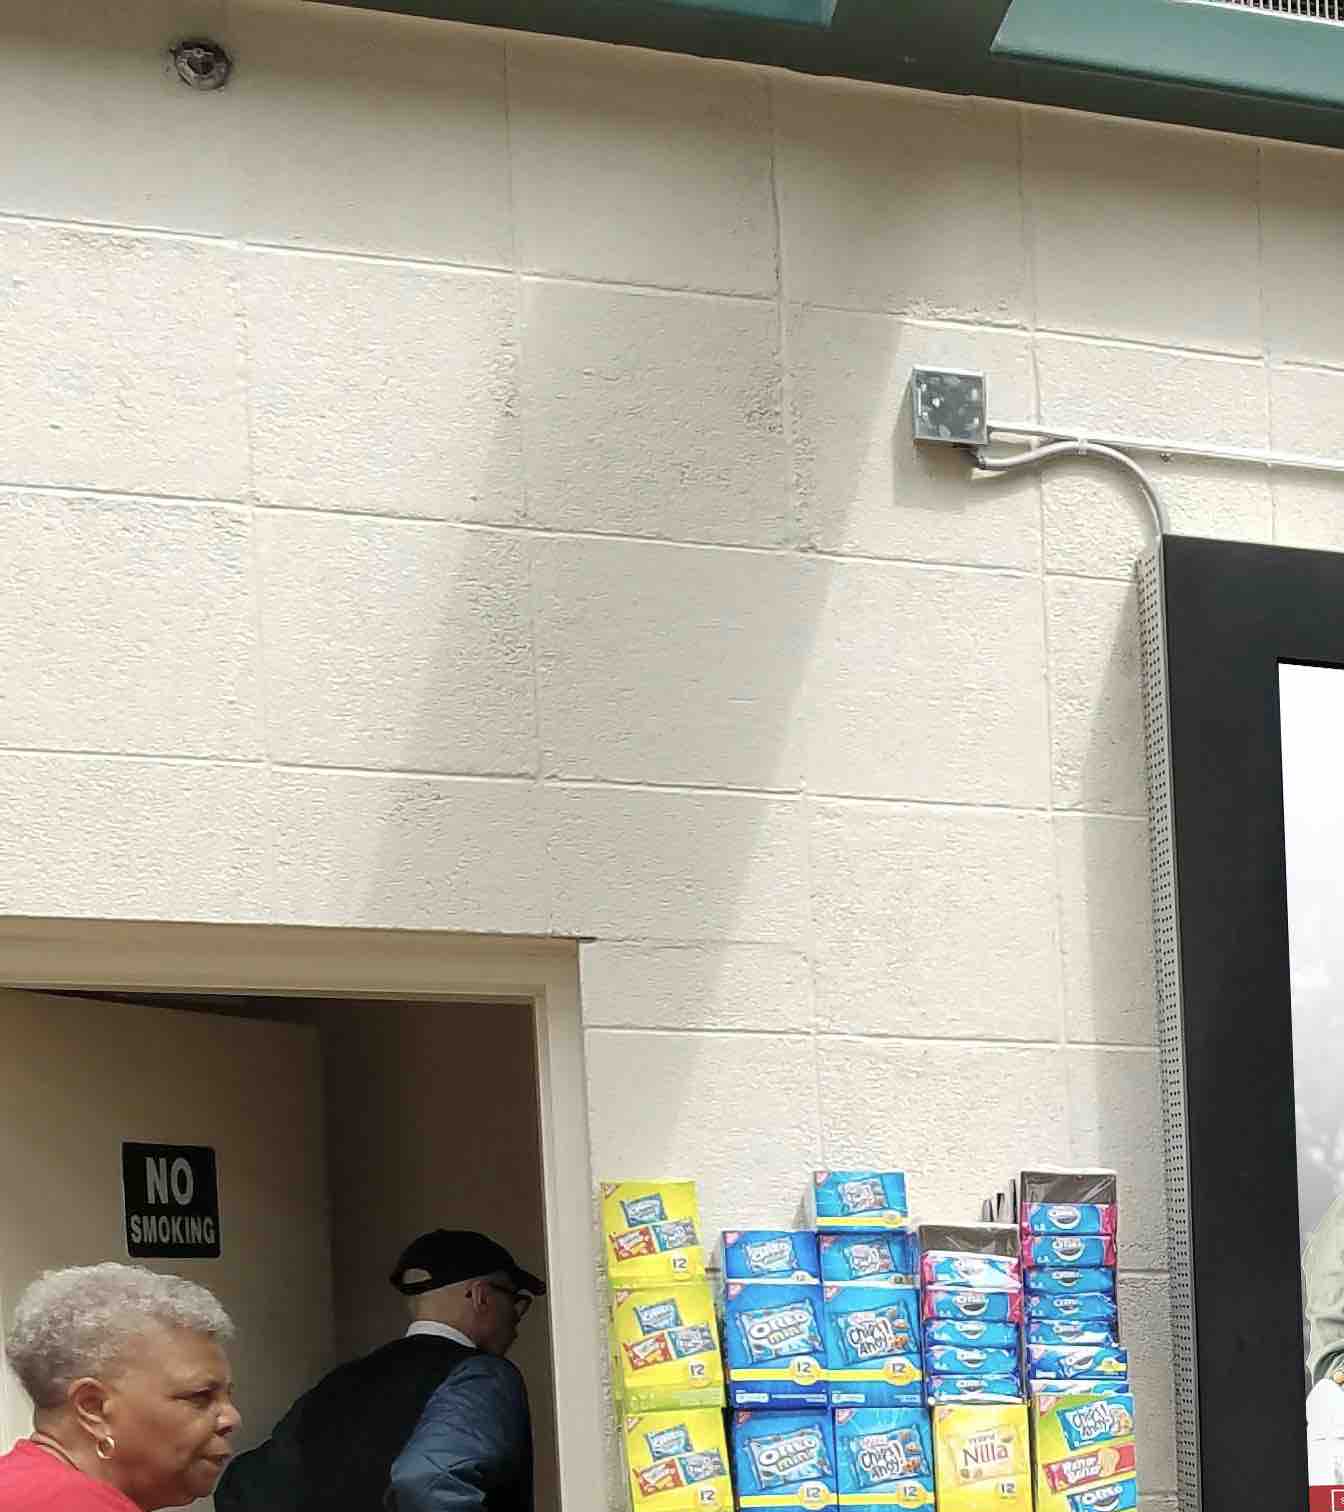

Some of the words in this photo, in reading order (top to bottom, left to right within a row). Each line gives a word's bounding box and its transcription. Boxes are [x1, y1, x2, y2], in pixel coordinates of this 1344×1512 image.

[145, 1157, 193, 1206] NO
[130, 1214, 215, 1244] SMOKING
[672, 1258, 687, 1269] 12
[750, 1307, 809, 1340] OREO
[759, 1439, 816, 1466] OREO
[963, 1443, 1008, 1467] Nilla
[700, 1490, 715, 1502] 12
[807, 1486, 820, 1498] 12
[904, 1486, 917, 1497] 12
[1001, 1483, 1015, 1493] 12
